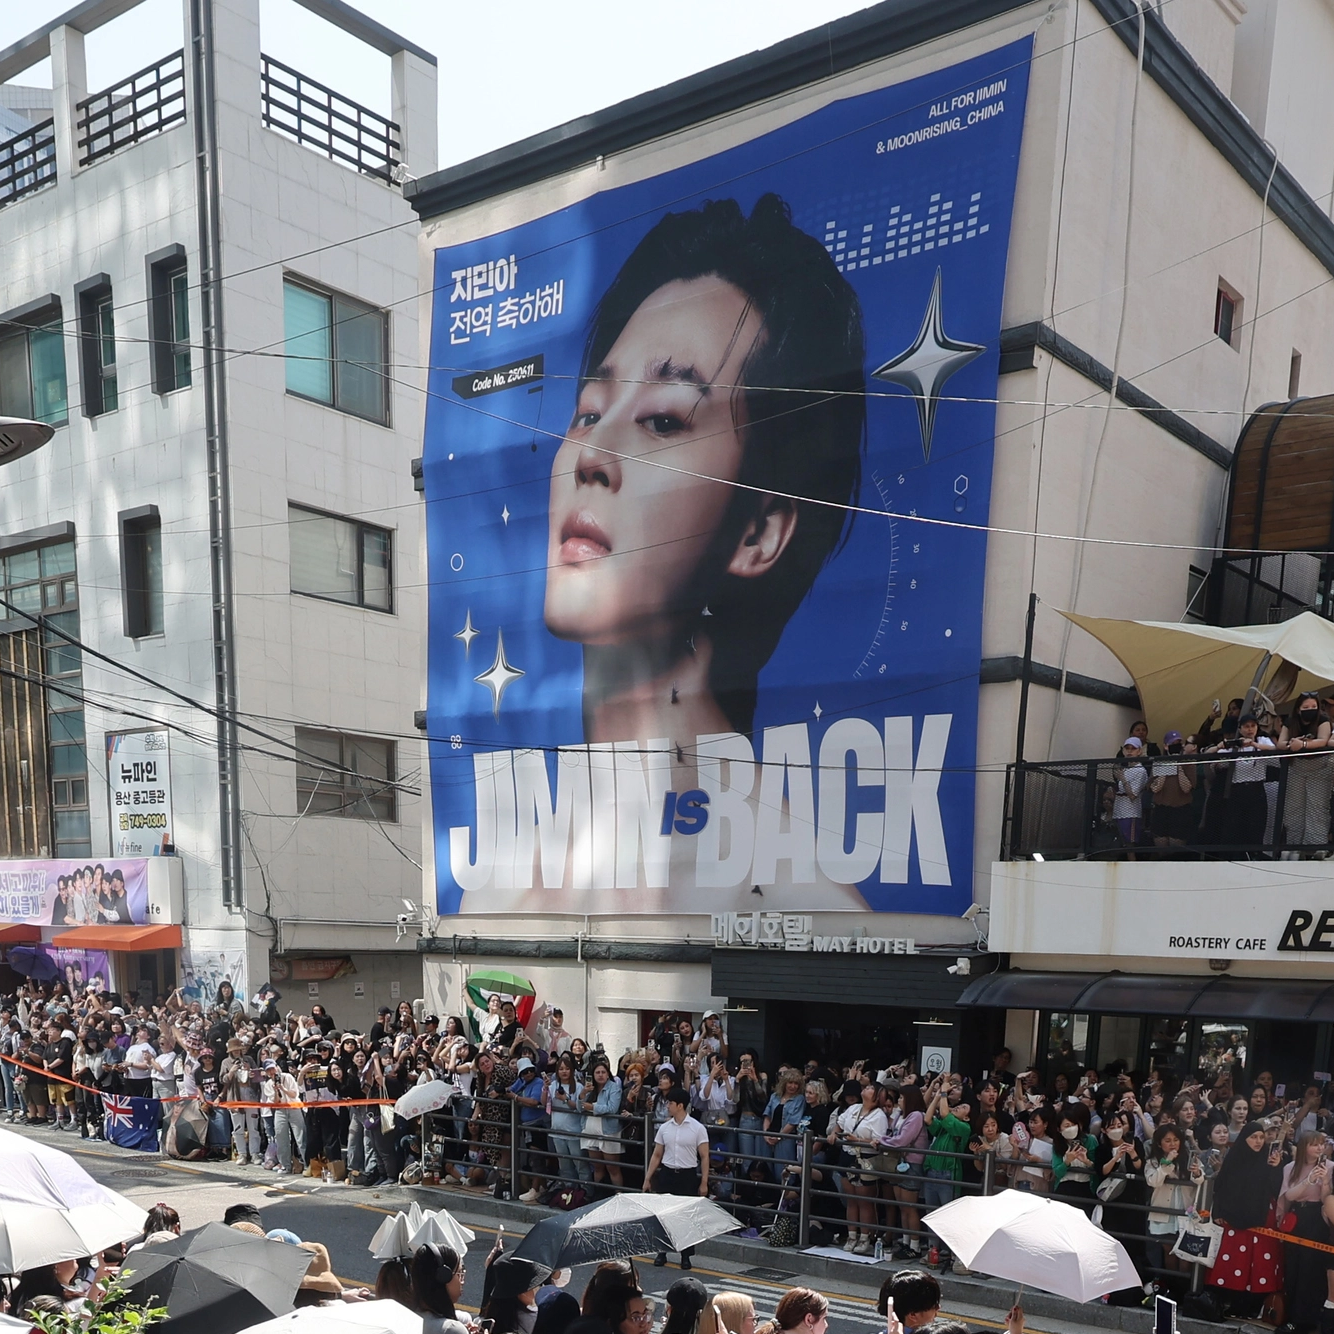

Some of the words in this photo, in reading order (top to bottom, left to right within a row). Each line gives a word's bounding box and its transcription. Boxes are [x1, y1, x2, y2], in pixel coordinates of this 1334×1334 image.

[928, 101, 949, 119] ALL
[951, 92, 975, 111] FOR
[975, 78, 1007, 104] JIMIN
[876, 141, 885, 154] &
[887, 100, 1004, 152] MOONRISING_CHINA
[450, 254, 518, 303] 지민아
[450, 303, 493, 345] 전역
[497, 279, 564, 329] 축하해
[472, 375, 491, 392] Code
[493, 373, 506, 388] No.
[507, 363, 535, 384] 250611
[897, 474, 905, 485] 10
[913, 543, 920, 554] 30
[910, 578, 917, 590] 40
[900, 620, 909, 631] 50
[878, 663, 887, 674] 60
[121, 761, 157, 783] 뉴파인
[115, 791, 131, 805] 용산
[133, 790, 165, 805] 중고등관
[695, 713, 953, 888] BACK
[129, 813, 167, 828] 749-0304
[449, 738, 671, 891] JIMIN
[660, 788, 709, 835] IS
[11, 895, 40, 915] 있을게
[711, 912, 813, 951] 메이호텔
[813, 936, 853, 953] MAY
[856, 936, 920, 955] HOTEL
[1169, 936, 1230, 949] ROASTERY
[1235, 937, 1267, 950] CAFE
